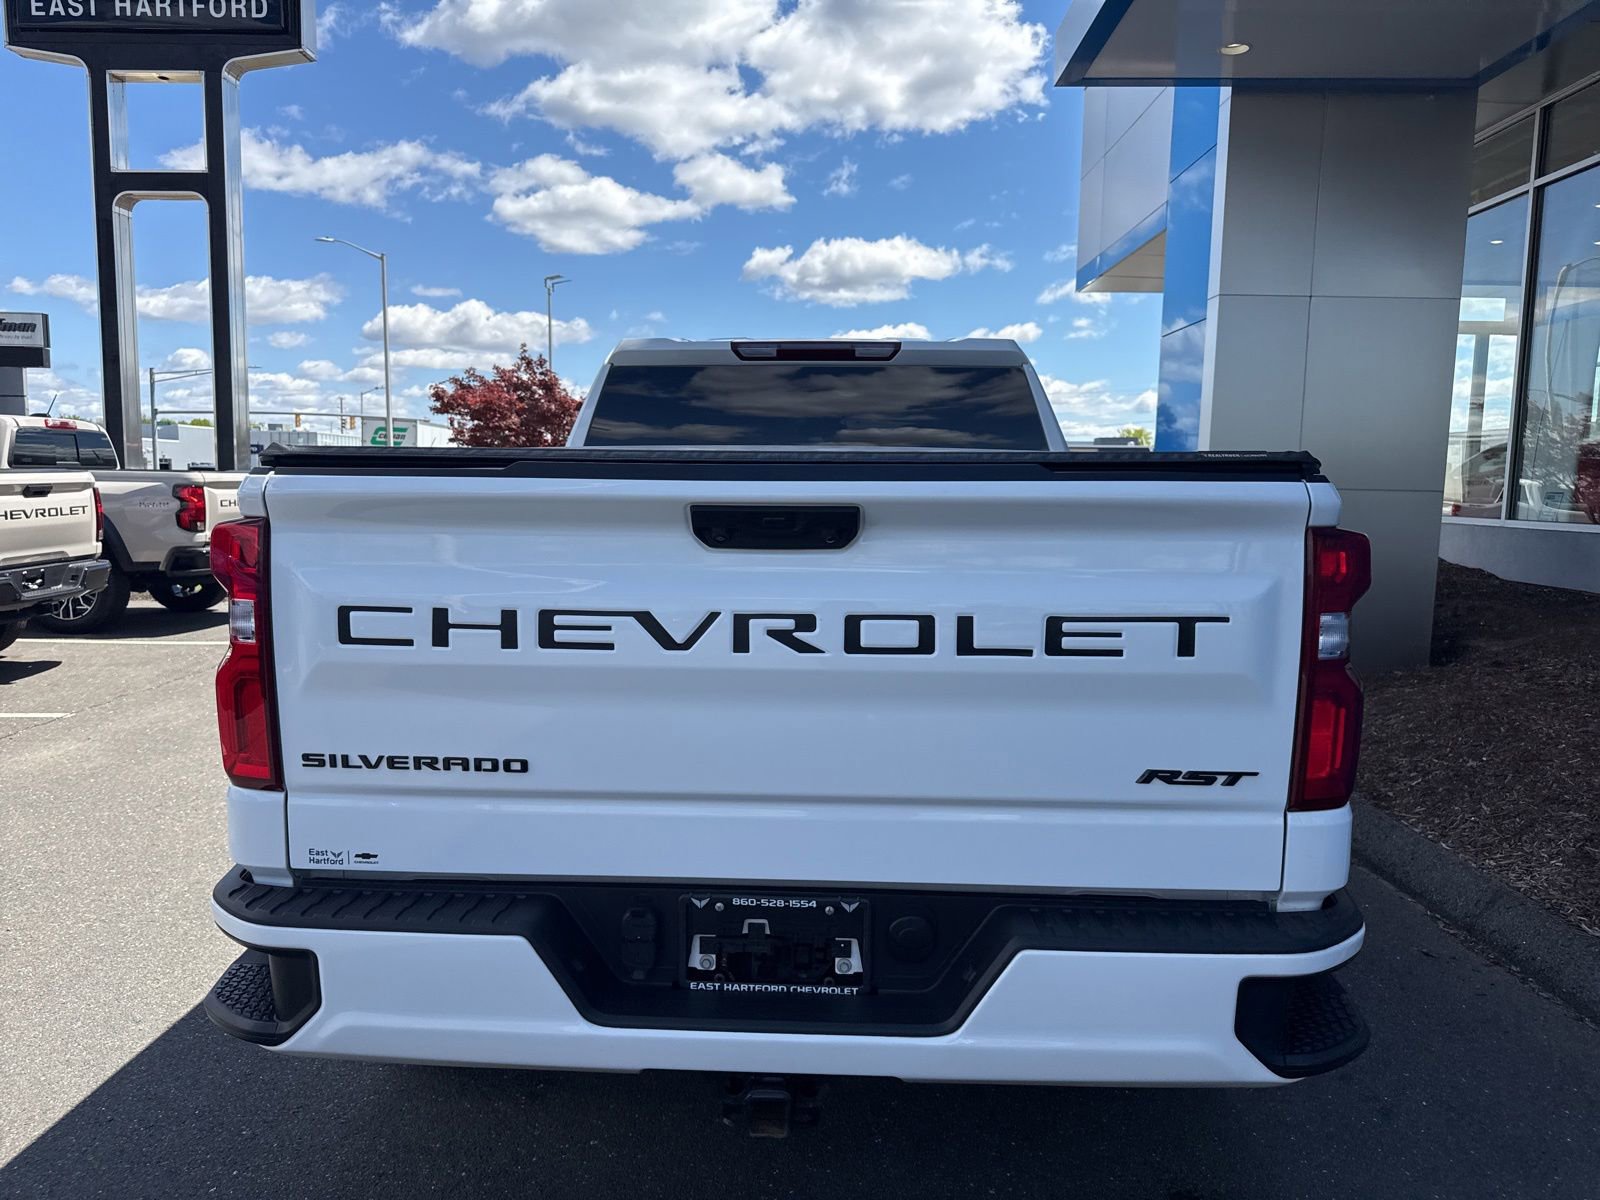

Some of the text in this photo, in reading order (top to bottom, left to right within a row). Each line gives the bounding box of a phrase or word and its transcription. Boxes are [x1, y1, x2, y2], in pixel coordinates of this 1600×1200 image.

[30, 0, 268, 18] EAST HARTFORD
[338, 605, 1230, 658] CHEVROLET
[301, 753, 529, 773] SILVERADO
[1135, 768, 1260, 786] RST
[309, 848, 329, 857] East
[309, 857, 344, 866] Hartford
[732, 897, 817, 908] 860-528-1554
[690, 982, 859, 995] EAST HARTFORD CHEVROLET
